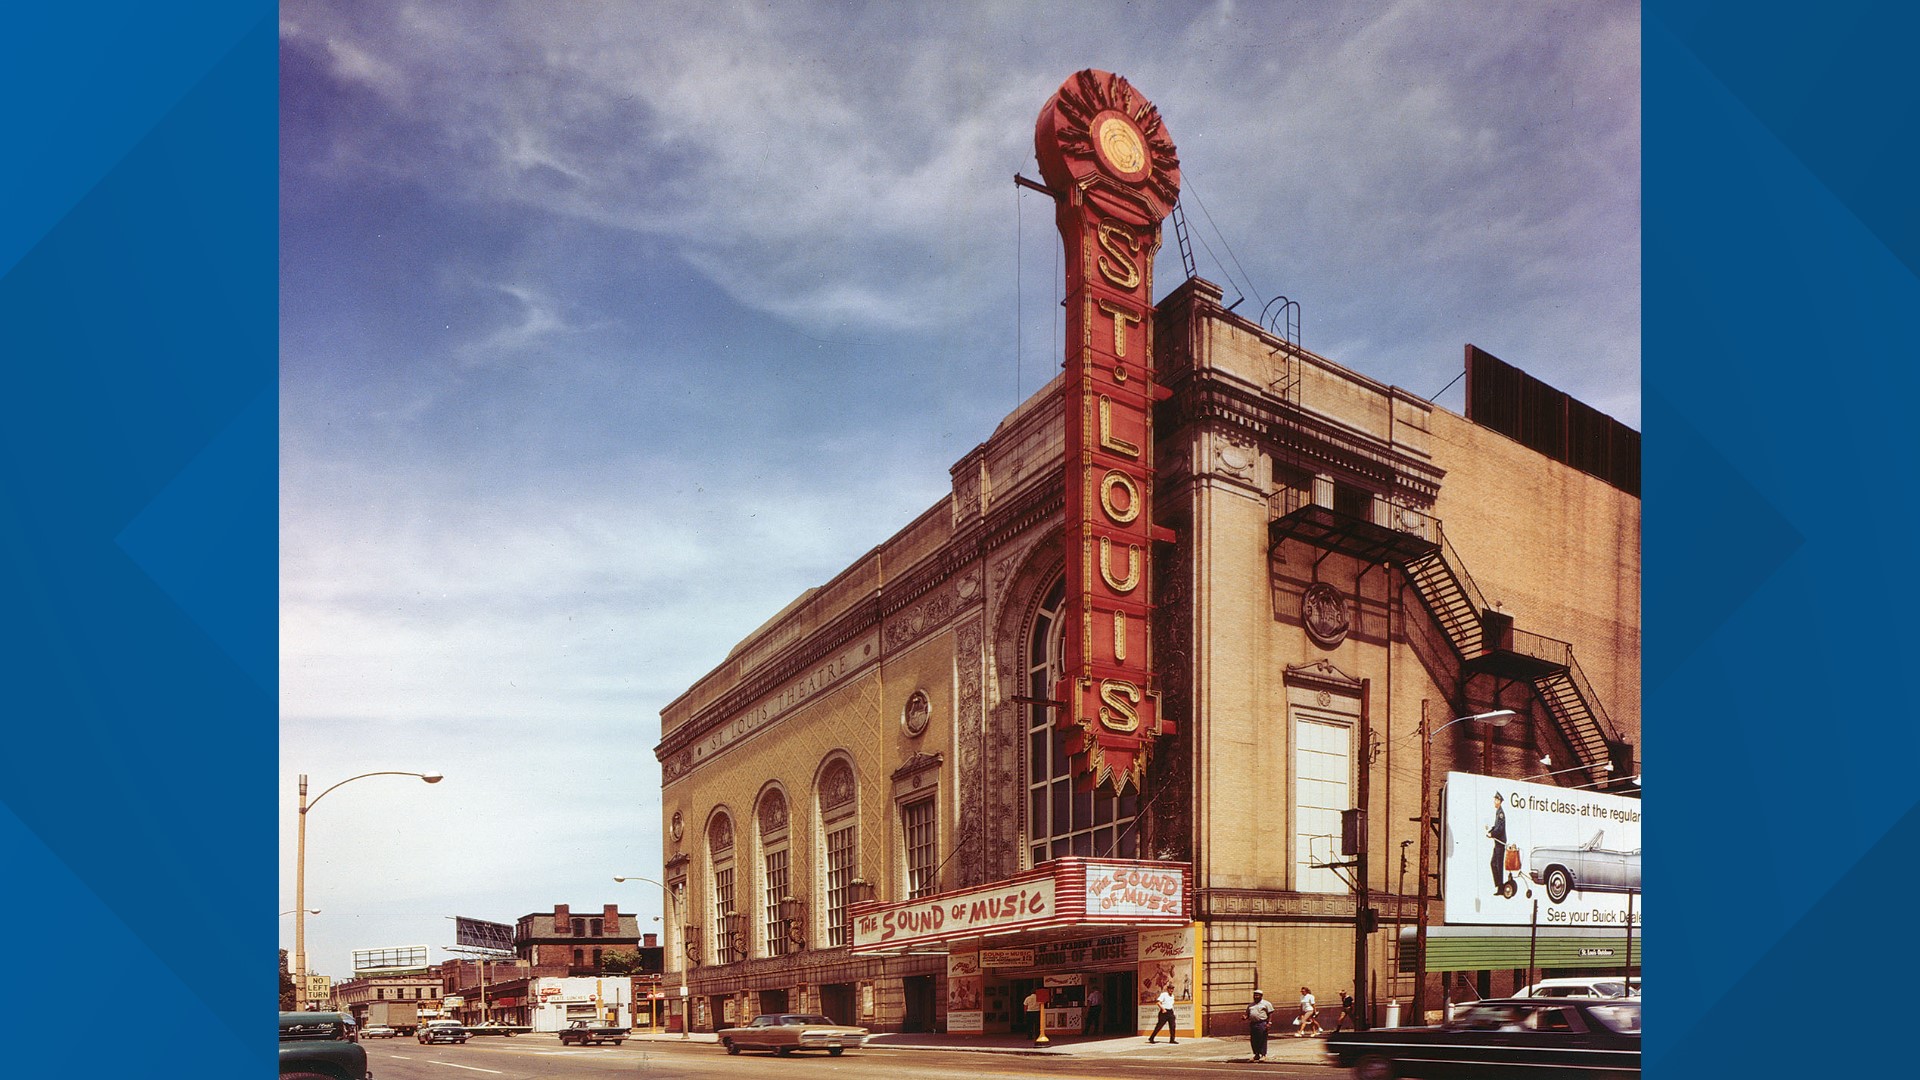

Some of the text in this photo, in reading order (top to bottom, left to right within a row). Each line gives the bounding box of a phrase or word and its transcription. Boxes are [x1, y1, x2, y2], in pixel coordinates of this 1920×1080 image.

[1098, 393, 1141, 732] LOUIS
[731, 704, 768, 738] LOUIS
[778, 655, 846, 711] THEATRE
[1510, 792, 1526, 809] Go
[1528, 796, 1548, 812] first
[1592, 804, 1607, 819] the
[1609, 808, 1641, 824] regular
[1088, 869, 1178, 896] THE SOUND
[1101, 891, 1117, 910] OF
[858, 914, 878, 935] THE
[880, 905, 945, 942] SOUND
[951, 903, 967, 920] OF
[1547, 907, 1566, 922] See
[1569, 911, 1590, 926] your
[1592, 909, 1617, 923] Buick
[1071, 949, 1086, 962] OF
[1092, 944, 1128, 960] MUSIC
